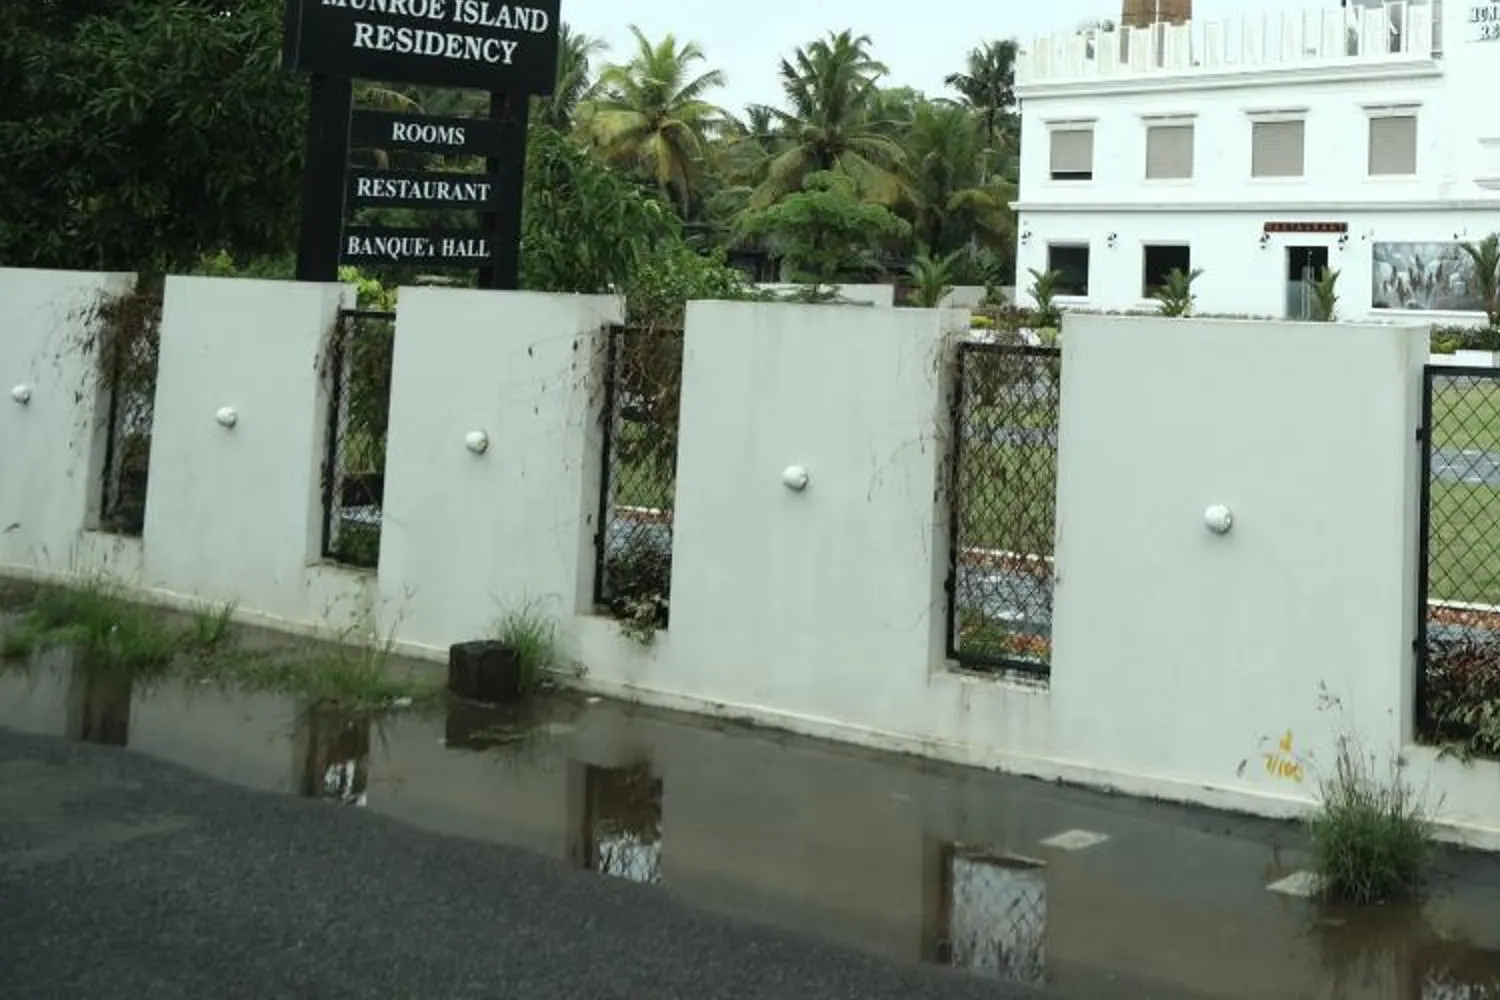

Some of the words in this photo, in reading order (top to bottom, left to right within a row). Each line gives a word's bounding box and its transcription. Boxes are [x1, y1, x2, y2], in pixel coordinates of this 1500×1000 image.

[353, 22, 518, 64] RESIDENCY
[392, 121, 466, 145] ROOMS
[357, 177, 491, 201] RESTAURANT
[441, 238, 490, 257] HALL
